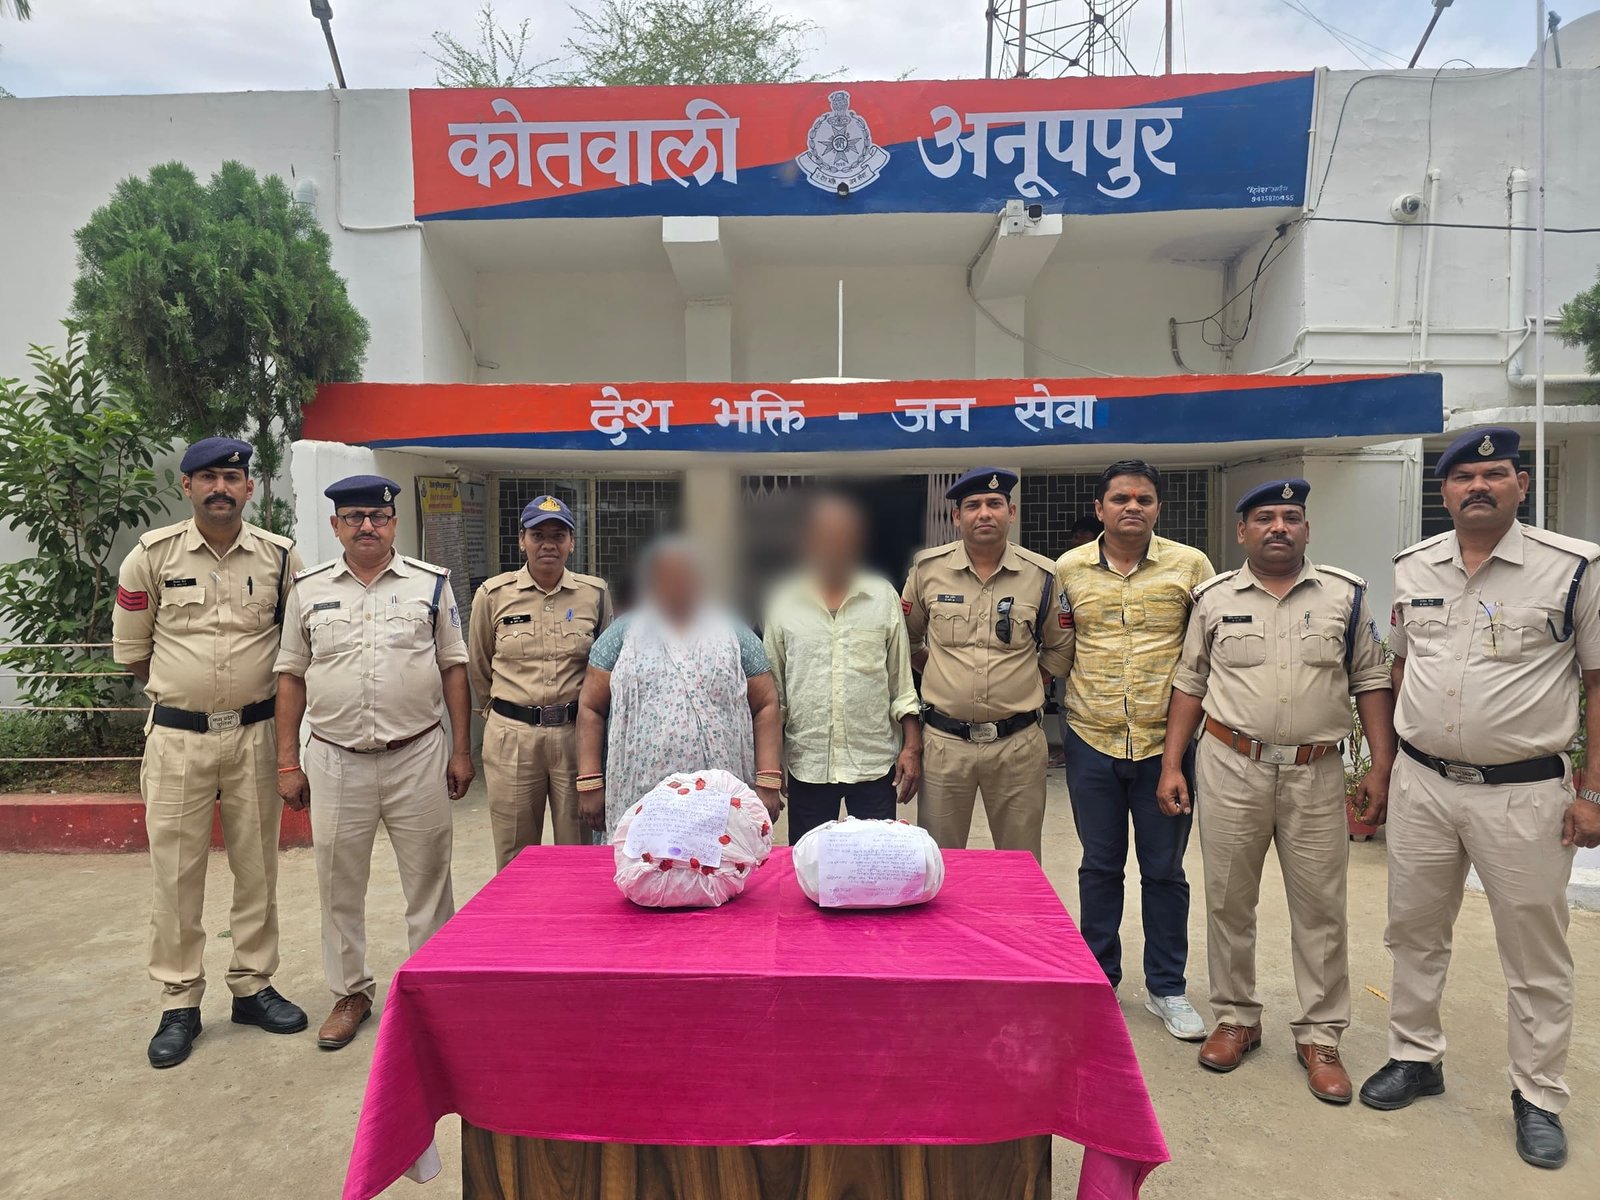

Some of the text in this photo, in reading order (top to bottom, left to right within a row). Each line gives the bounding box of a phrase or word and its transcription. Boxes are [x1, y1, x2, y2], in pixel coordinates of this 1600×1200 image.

[447, 97, 1183, 199] कोतवाली अनूपपुर
[590, 386, 675, 446] देश
[710, 389, 804, 435] भक्ति
[891, 397, 976, 432] जन
[1014, 384, 1097, 432] सेवा
